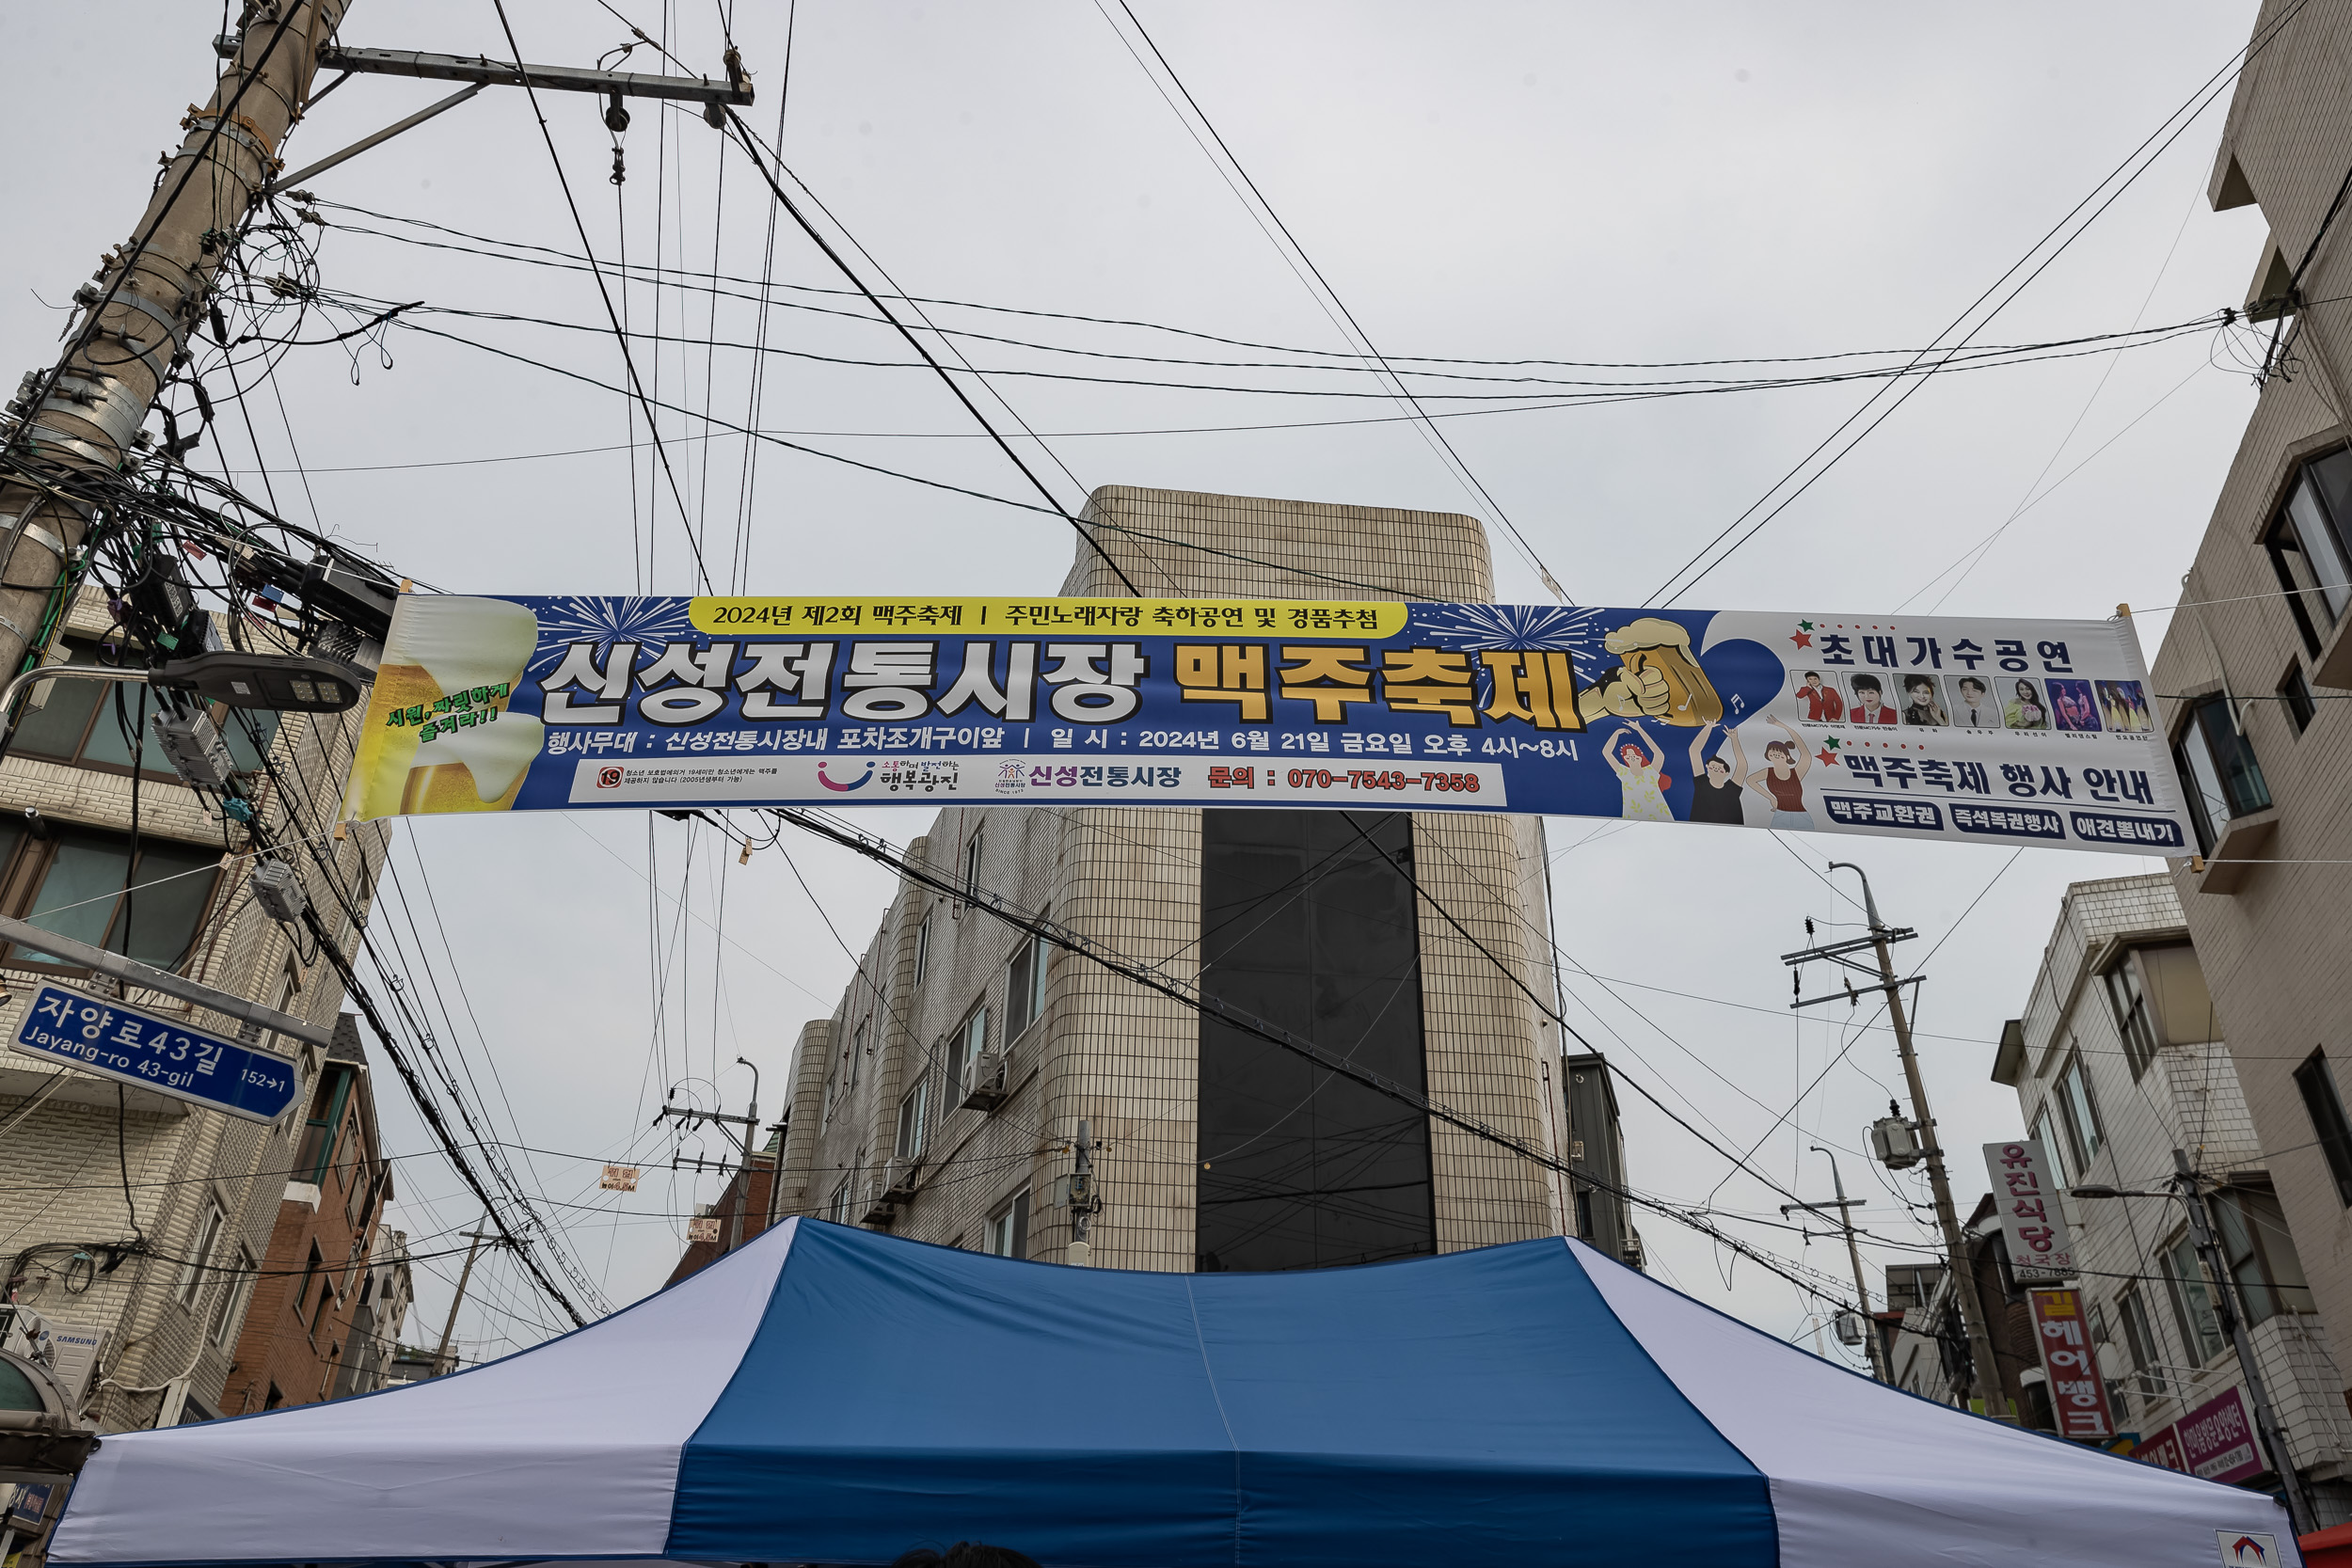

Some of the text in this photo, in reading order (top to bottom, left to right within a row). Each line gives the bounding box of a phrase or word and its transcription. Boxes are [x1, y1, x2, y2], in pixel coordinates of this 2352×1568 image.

[713, 605, 1379, 630] 2024년 제2회 맥주축제 주민노래자랑 축하공연 및 경품추첨
[1820, 635, 2074, 673] 초대가수공연
[537, 641, 1586, 733] 신성전통시장 맥주축제
[386, 682, 511, 727] 시원,짜릿하게
[419, 706, 499, 743] 즐겨라!!
[547, 731, 638, 754] 행사무대
[664, 728, 829, 751] 신성전통시장내
[837, 726, 1005, 750] 포차조개구이앞
[1138, 730, 1219, 750] 2024년
[1231, 731, 1270, 751] 6월
[1280, 732, 1330, 752] 21일
[1341, 732, 1412, 755] 금요일
[1423, 734, 1471, 756] 오후
[1481, 736, 1579, 761] 4시~8시
[601, 769, 622, 785] 19
[882, 760, 960, 771] 소통하며 발전하는
[1028, 766, 1181, 788] 신성전통시장
[880, 772, 959, 792] 행복광진
[1208, 766, 1255, 789] 문의
[1287, 768, 1481, 793] 070-7543-7358
[1843, 755, 2155, 804] 맥주축제 행사 안내
[1830, 800, 1936, 825] 맥주교환권
[1953, 808, 2059, 834] 즉석복권행사
[2076, 816, 2175, 842] 애견뽐내기
[38, 995, 224, 1076] 자양로43길
[25, 1025, 195, 1088] Jayang-ro 43-gil
[1999, 1144, 2055, 1252] 유진식당
[56, 1335, 97, 1346] SAMSUNG
